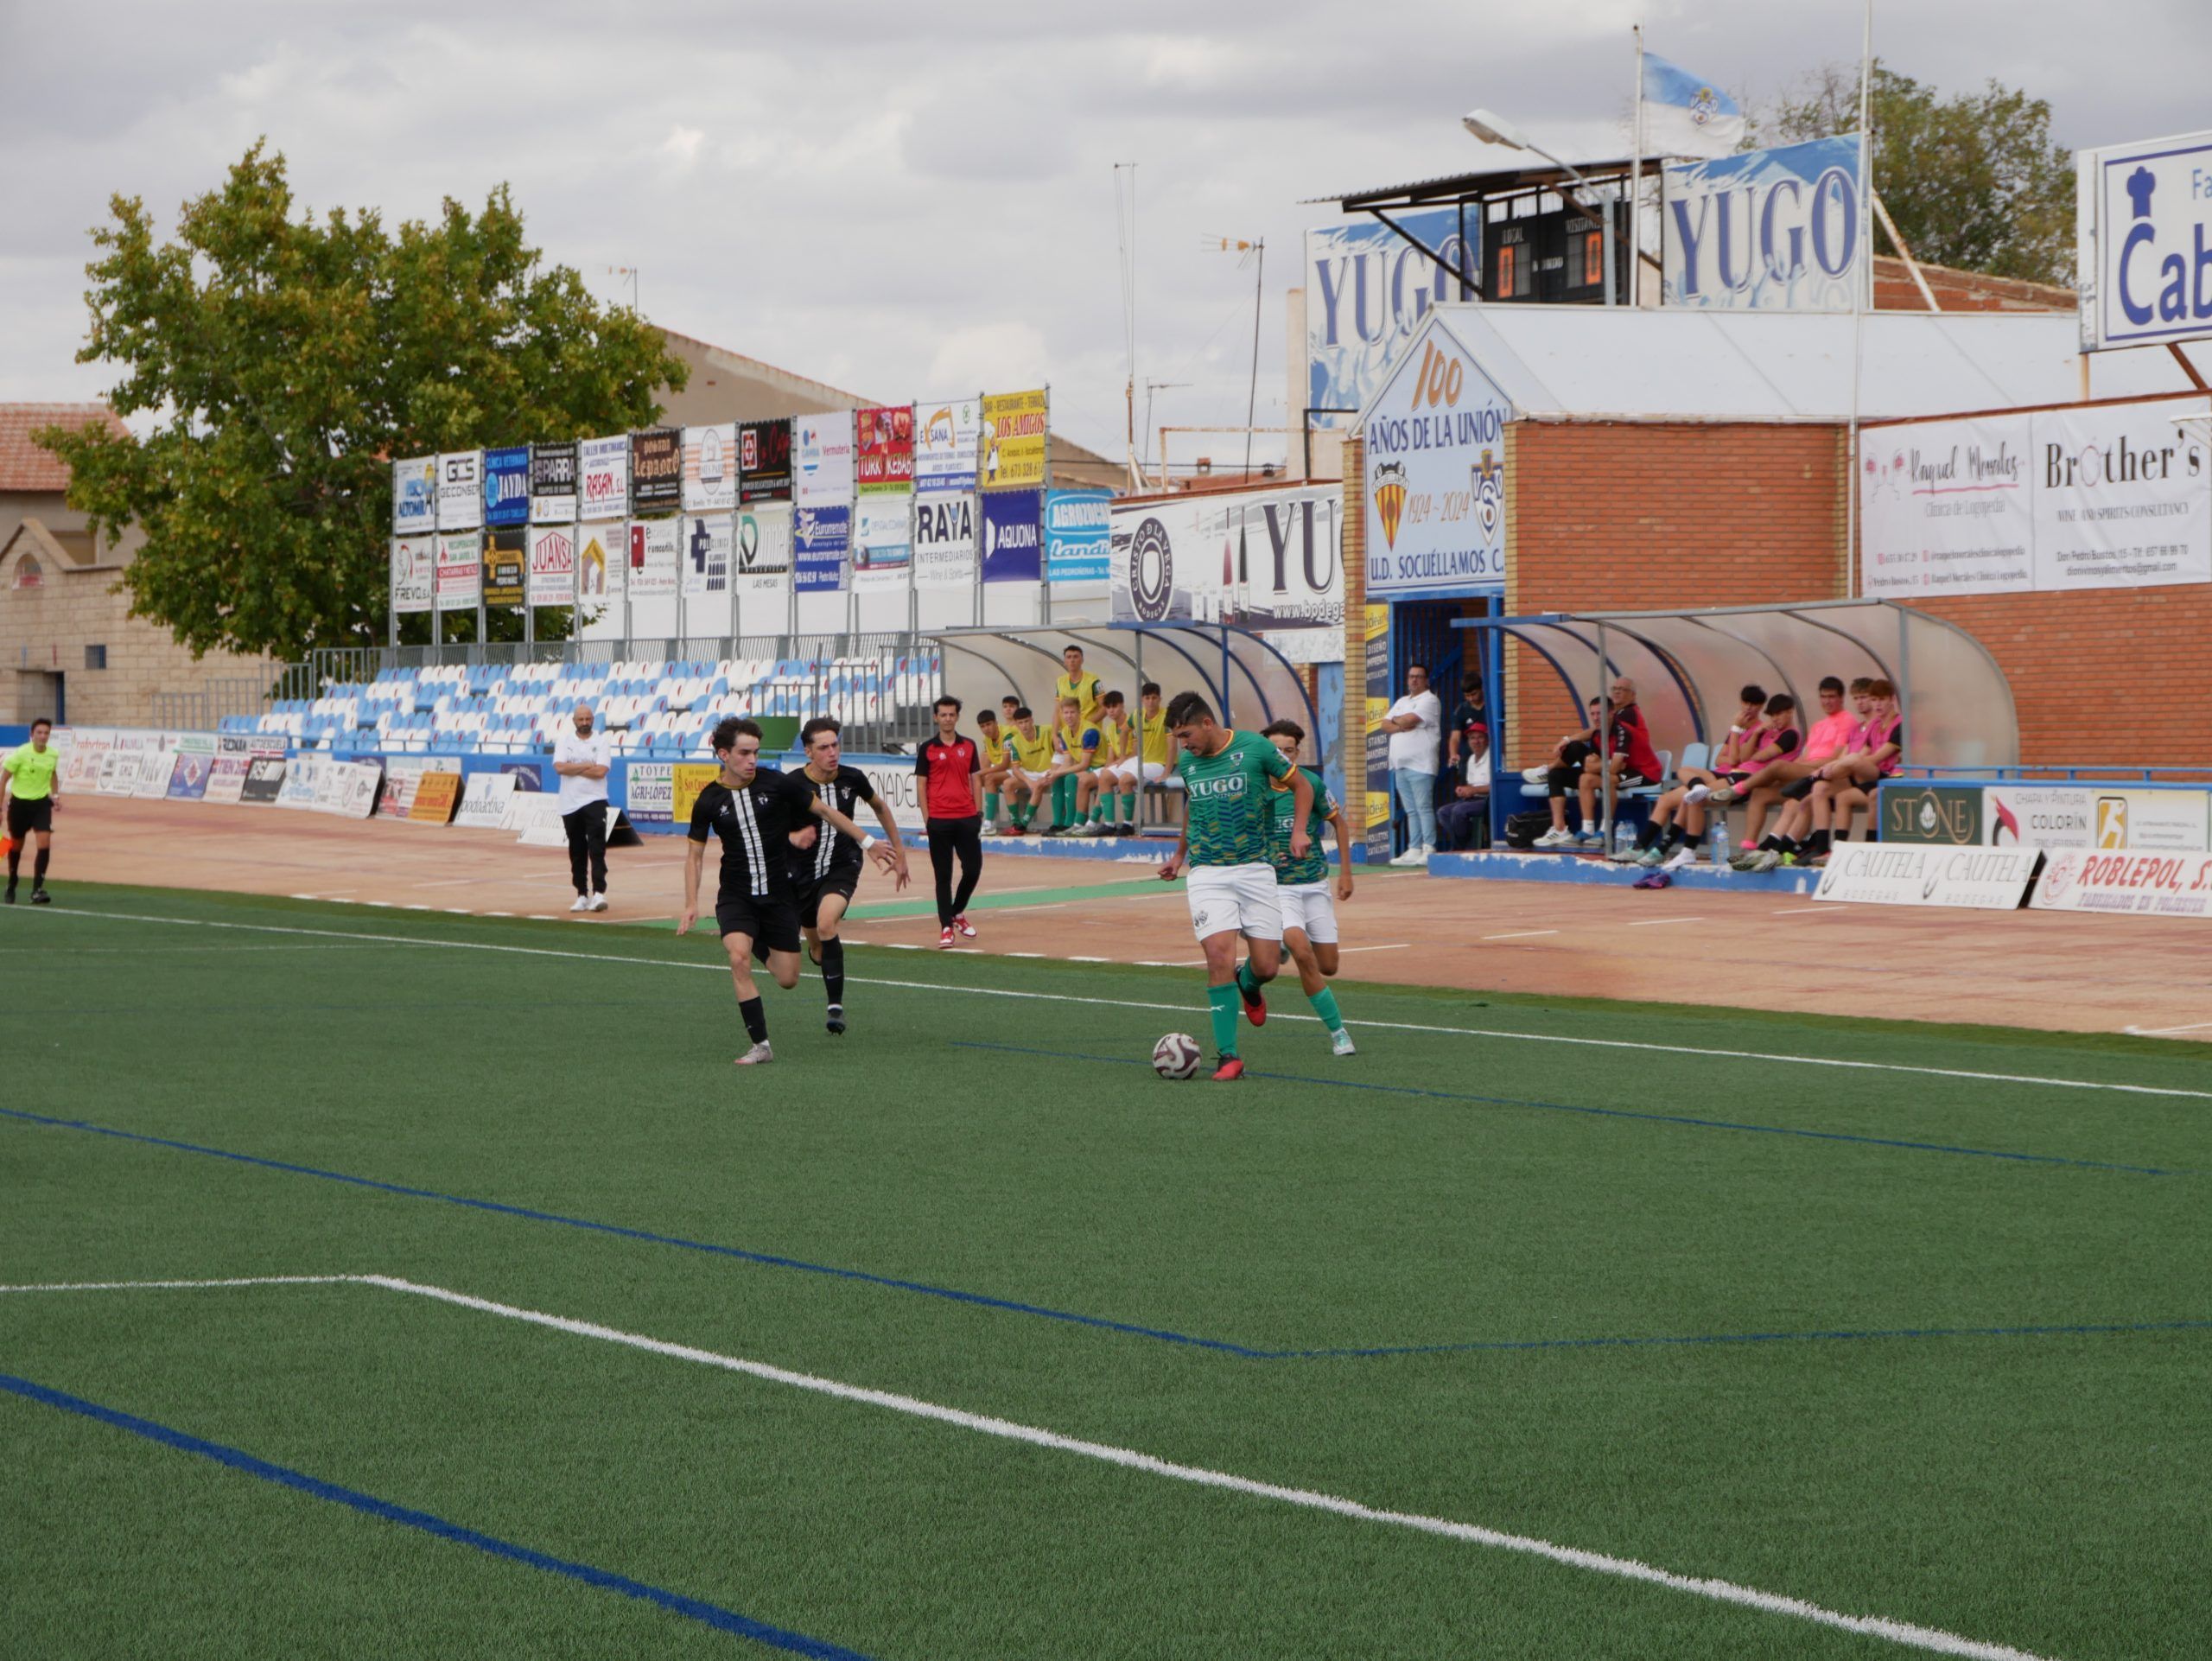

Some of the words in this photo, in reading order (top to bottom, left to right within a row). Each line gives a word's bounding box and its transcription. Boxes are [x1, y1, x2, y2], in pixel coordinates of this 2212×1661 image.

[1502, 227, 1525, 245] LOCAL
[1669, 165, 1858, 299] YUGO
[2120, 222, 2212, 326] Cab
[1314, 234, 1478, 350] YUGO
[1411, 338, 1464, 411] 100
[997, 397, 1024, 412] RESTAURANTE
[997, 415, 1012, 440] LOS
[1014, 412, 1046, 437] AMIGOS
[1369, 416, 1409, 455] AÑOS
[1414, 416, 1431, 449] DE
[1435, 413, 1453, 448] LA
[1459, 398, 1507, 444] UNIÓN
[584, 443, 598, 457] TALLER
[860, 454, 881, 476] TURK
[887, 452, 913, 476] KEBAB
[447, 457, 474, 483] GCS
[543, 457, 576, 484] PARRA
[1911, 444, 1958, 498] Raquel
[1968, 441, 2018, 481] Morales
[498, 473, 527, 504] JAYDA
[1408, 492, 1432, 524] 1924
[1440, 489, 1471, 524] 2024
[2130, 501, 2189, 520] CONSULTANCY
[918, 500, 972, 544] RAYA
[998, 523, 1038, 550] AQUONA
[532, 536, 573, 571] JUANSA
[917, 549, 974, 564] INTERMEDIARIOS
[1132, 530, 1146, 592] CRISTO
[1262, 498, 1344, 595] YU
[1371, 557, 1393, 581] U.D.
[1399, 549, 1485, 580] SOCUÉLLAMOS
[753, 579, 763, 589] LAS
[764, 578, 779, 588] MESAS
[1368, 640, 1387, 655] DISEÑO
[639, 766, 672, 777] TOYPE
[631, 783, 673, 801] AGRI-LÓPEZ
[1189, 776, 1243, 799] YUGO
[2016, 793, 2044, 805] CHAPA
[2051, 793, 2088, 806] PINTURA
[461, 796, 505, 816] podoactiva
[1891, 791, 1975, 844] STONE
[1845, 849, 1928, 880] CAUTELA
[1947, 851, 2033, 883] CAUTELA
[2076, 855, 2185, 896] ROBLEPOL,
